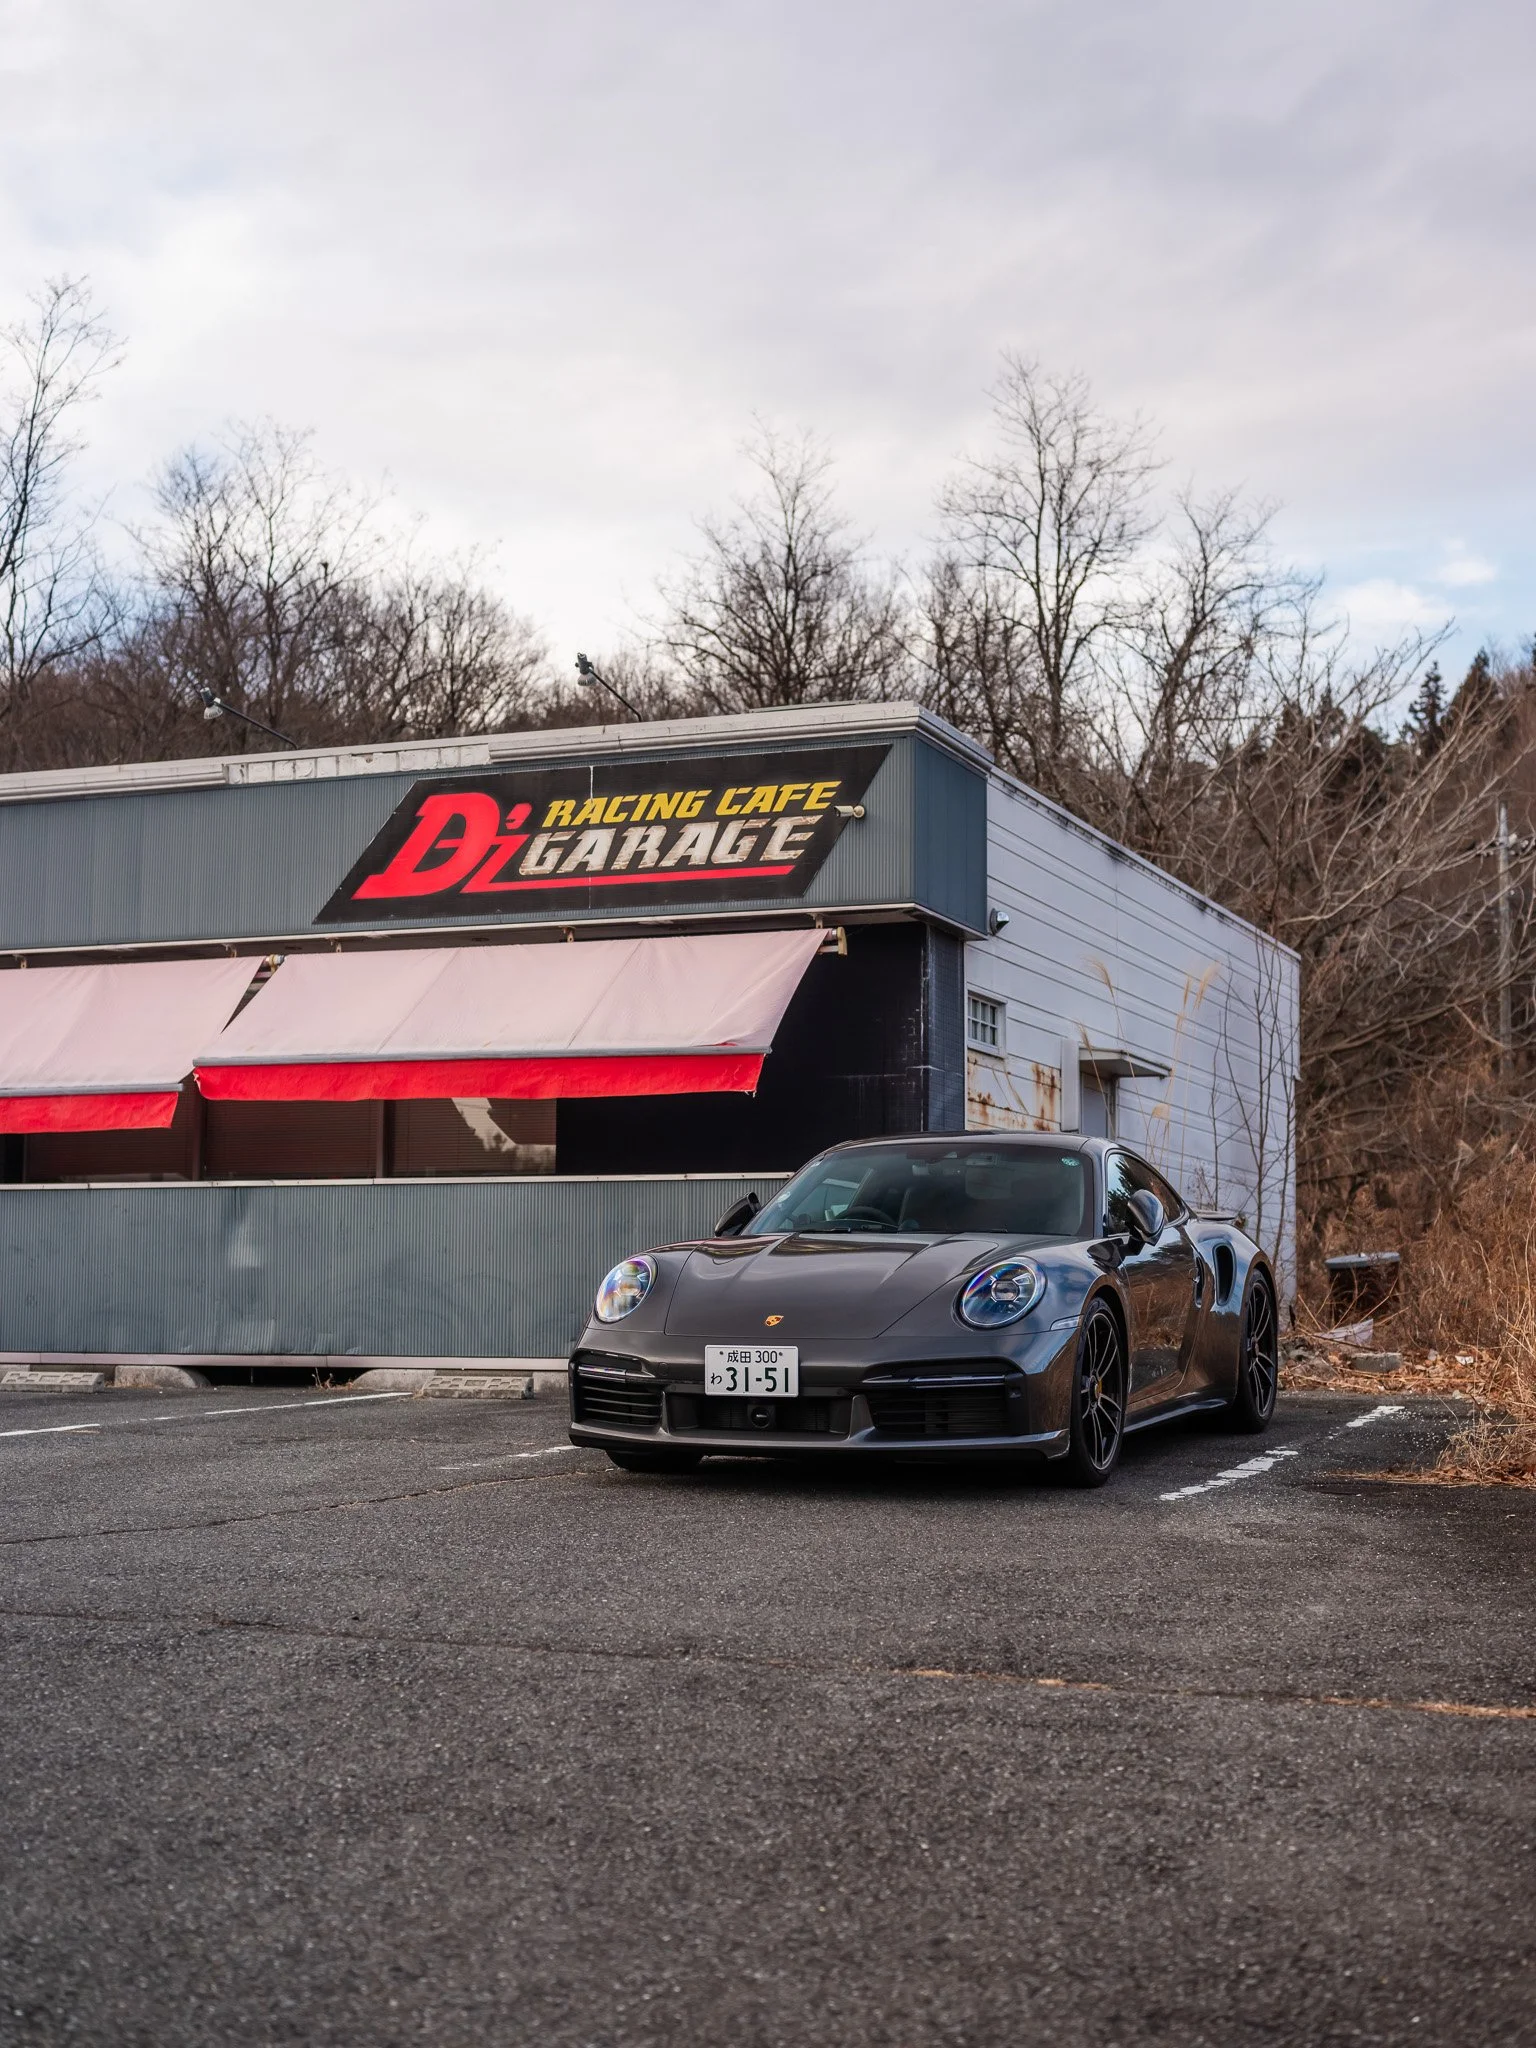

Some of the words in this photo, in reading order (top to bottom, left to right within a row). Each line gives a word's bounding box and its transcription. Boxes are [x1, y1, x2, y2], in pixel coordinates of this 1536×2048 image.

[542, 789, 712, 828] RACING
[715, 780, 842, 816] CAFE
[518, 815, 824, 876] GARAGE
[727, 1350, 751, 1364] 成田
[755, 1350, 778, 1364] 300
[710, 1372, 722, 1385] わ
[726, 1366, 789, 1392] 31-51
